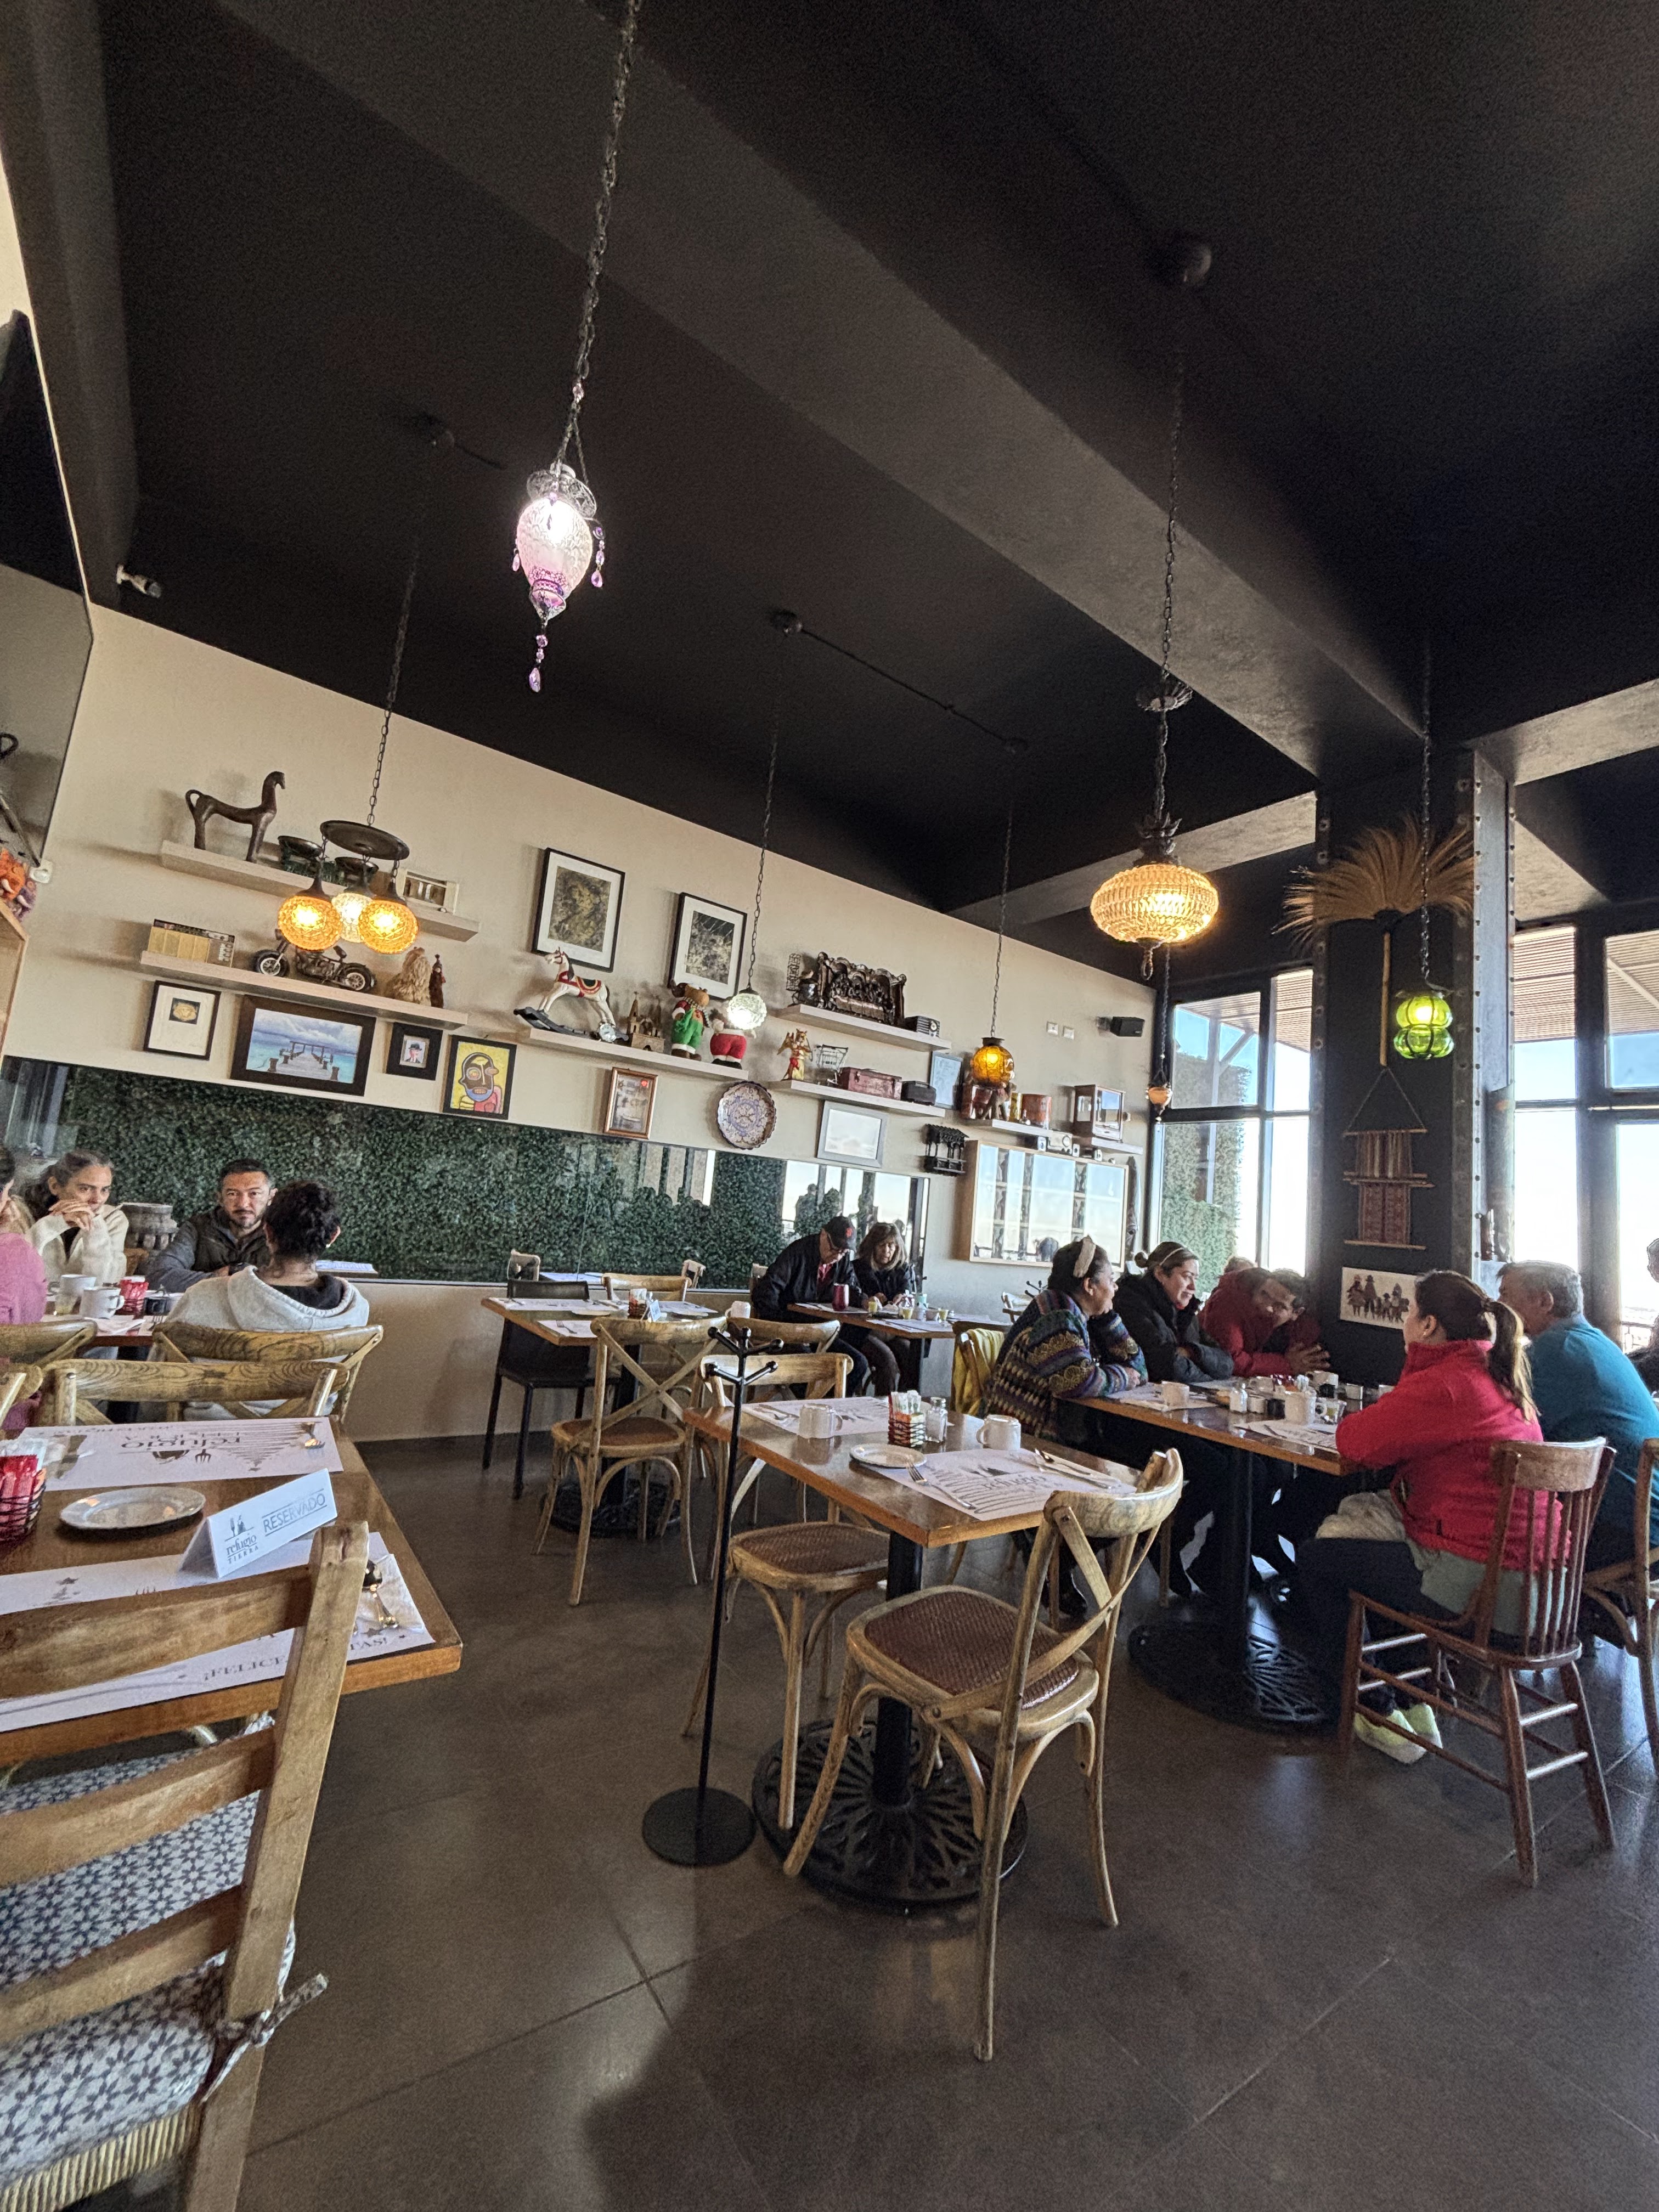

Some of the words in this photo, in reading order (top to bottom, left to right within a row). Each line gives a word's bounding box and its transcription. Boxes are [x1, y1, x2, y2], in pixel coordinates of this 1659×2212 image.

[263, 1493, 325, 1532] RESERVADO
[226, 1533, 257, 1555] refugio
[228, 1545, 258, 1564] TIERRA
[204, 1655, 288, 1680] ¡FELICE
